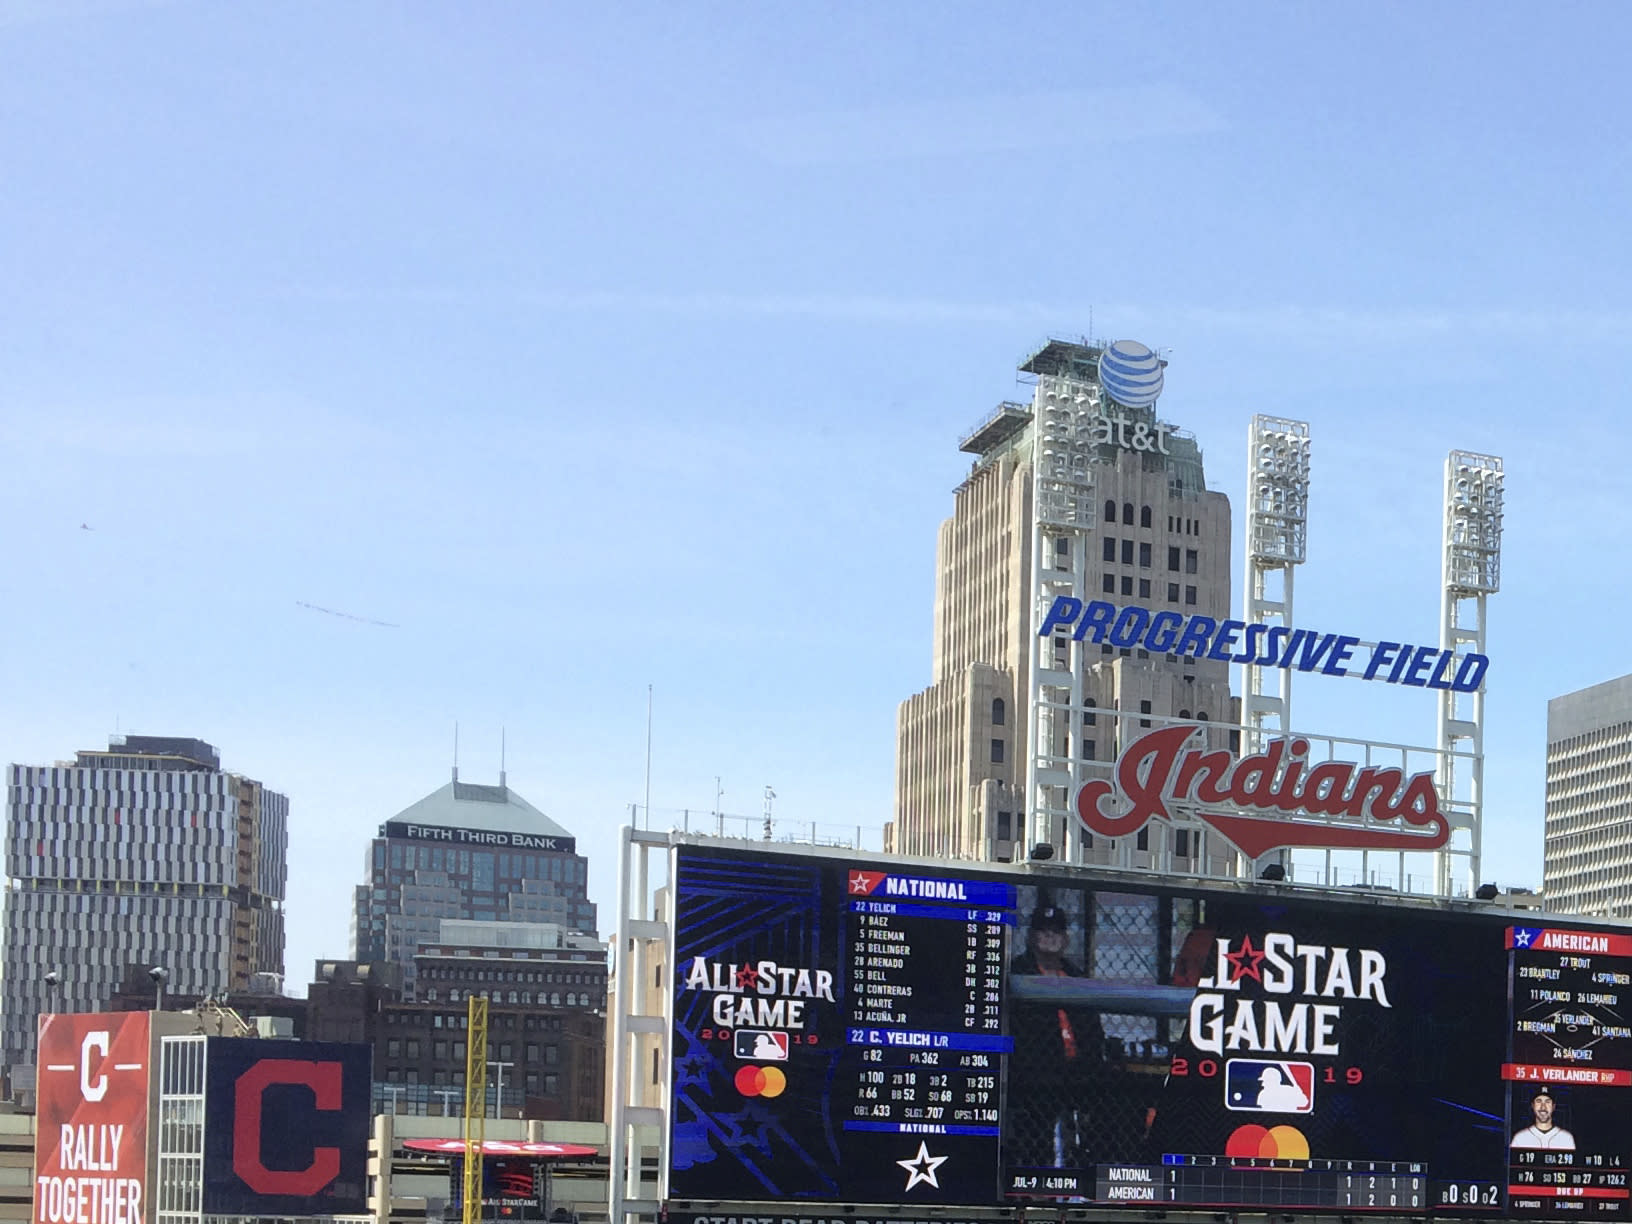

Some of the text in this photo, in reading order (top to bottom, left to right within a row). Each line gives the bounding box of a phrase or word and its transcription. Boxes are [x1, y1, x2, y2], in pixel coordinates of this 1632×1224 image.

[1038, 596, 1490, 693] PROGRESSIVE FIELD
[1076, 724, 1446, 842] Indians
[407, 825, 557, 849] FIFTH THIRD BANK
[886, 877, 967, 900] NATIONAL
[868, 930, 905, 941] FREEMAN
[1543, 933, 1608, 952] AMERICAN
[867, 957, 903, 968] ARENADO
[1264, 933, 1392, 1008] STAR
[686, 956, 836, 1002] ALL STAR
[867, 984, 912, 996] CONTRERAS
[713, 994, 805, 1029] GAME
[866, 998, 893, 1009] MARTE
[1190, 993, 1341, 1057] GAME
[852, 1030, 930, 1046] 22 YELICH
[80, 1031, 109, 1102] C
[922, 1052, 938, 1064] 362
[972, 1055, 988, 1067] 304
[867, 1071, 884, 1083] 100
[978, 1077, 994, 1088] 215
[1543, 1069, 1598, 1082] VERLANDER
[233, 1059, 343, 1195] C
[60, 1124, 123, 1171] RALLY
[1109, 1168, 1151, 1182] NATIONAL
[1108, 1187, 1153, 1200] AMERICAN
